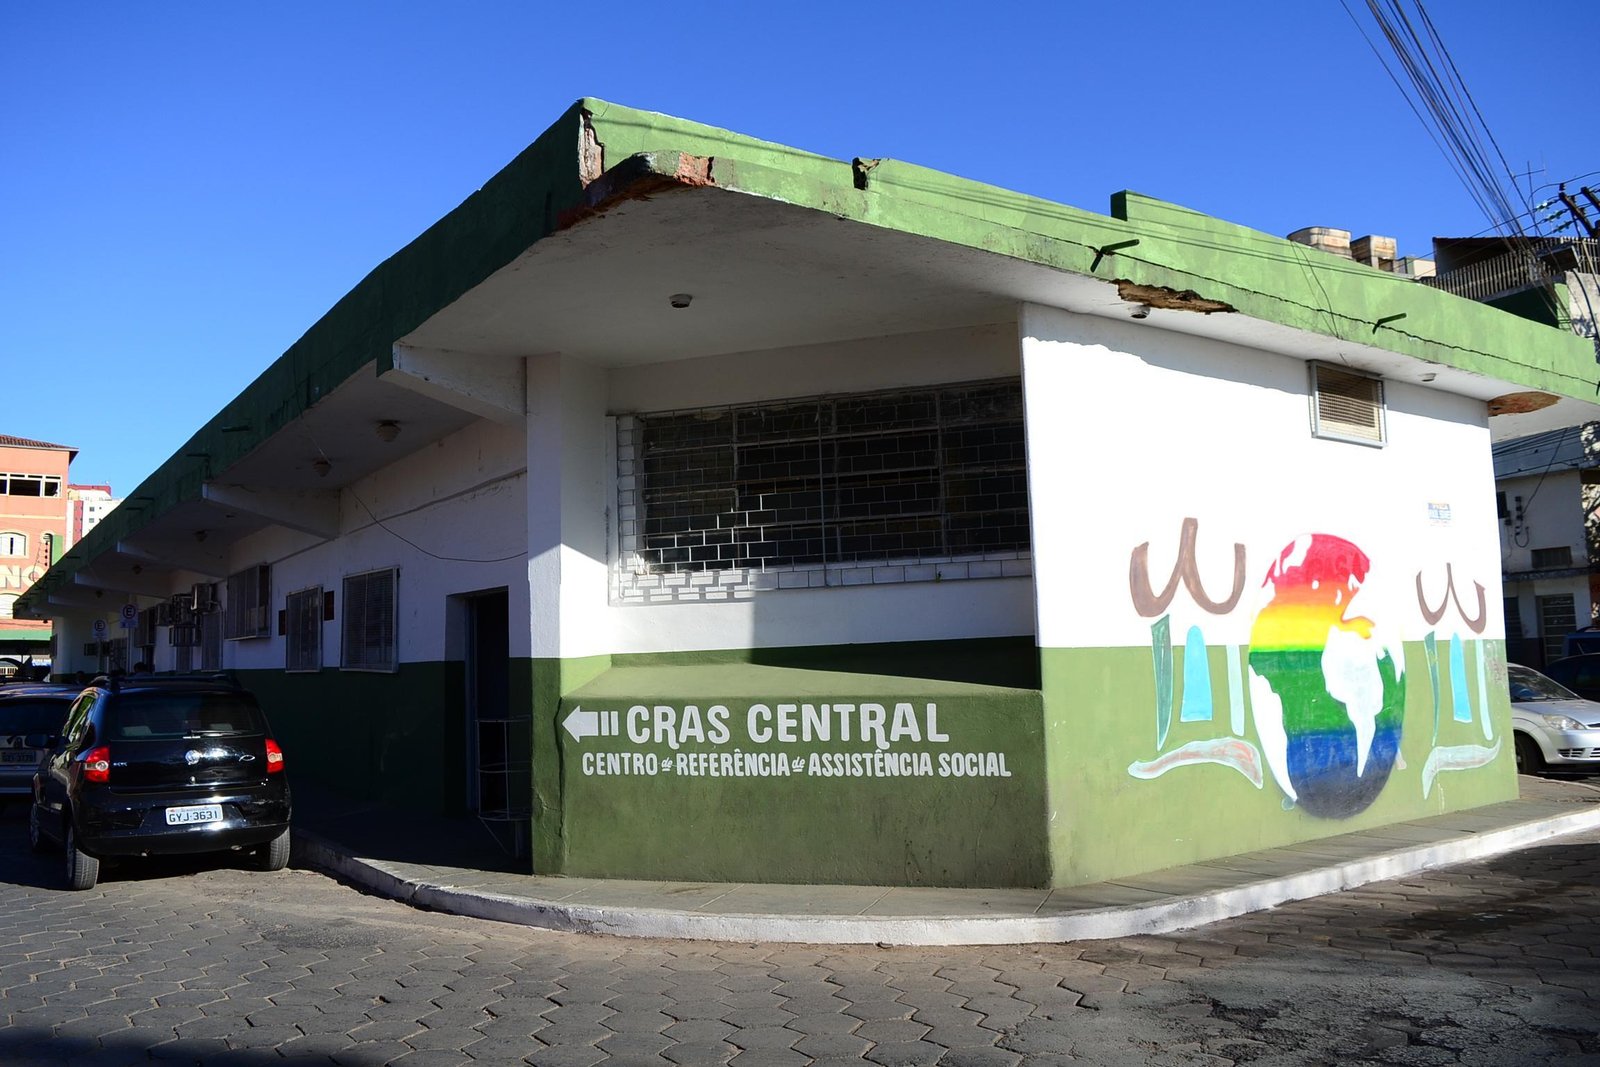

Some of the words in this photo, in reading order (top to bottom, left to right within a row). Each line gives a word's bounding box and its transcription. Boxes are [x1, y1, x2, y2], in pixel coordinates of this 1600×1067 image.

[627, 704, 730, 749] CRAS
[747, 703, 949, 749] CENTRAL
[582, 752, 658, 776] CENTRO
[661, 756, 673, 772] de
[676, 749, 790, 777] REFERÊNCIA
[792, 756, 806, 772] de
[808, 749, 933, 777] ASSISTÊNCIA
[938, 752, 1012, 777] SOCIAL
